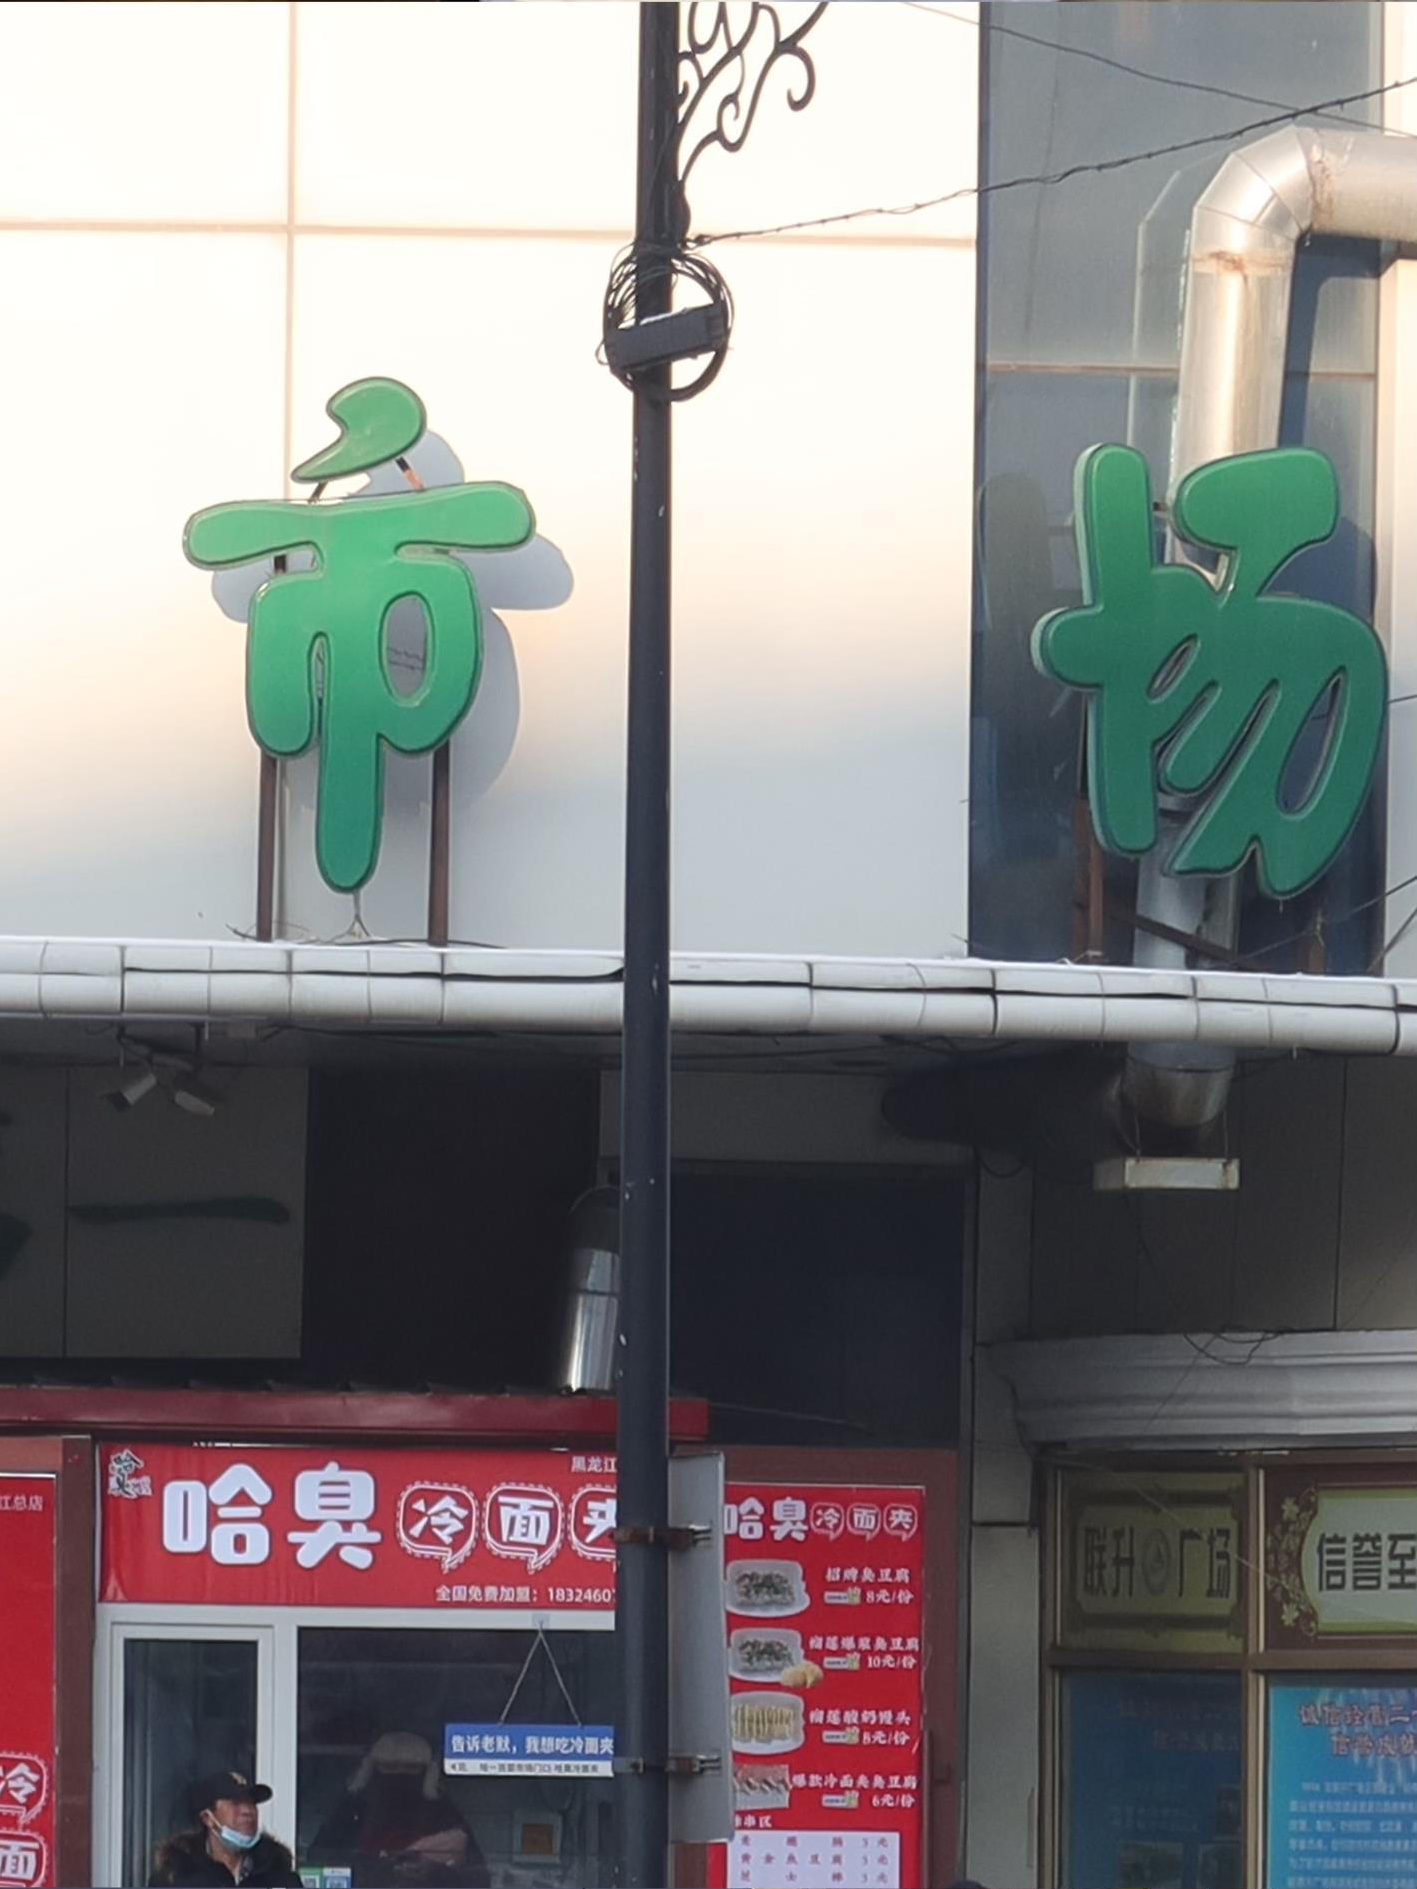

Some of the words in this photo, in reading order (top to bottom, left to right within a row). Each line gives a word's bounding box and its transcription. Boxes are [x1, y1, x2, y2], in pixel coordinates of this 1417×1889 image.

[162, 1460, 383, 1570] 哈臭
[723, 1496, 810, 1542] 哈臭
[814, 1506, 915, 1532] 冷面夹
[1083, 1526, 1136, 1601] 联升
[1178, 1527, 1232, 1601] 广场
[865, 1589, 915, 1605] 8元/份
[867, 1654, 917, 1669] 10元/份
